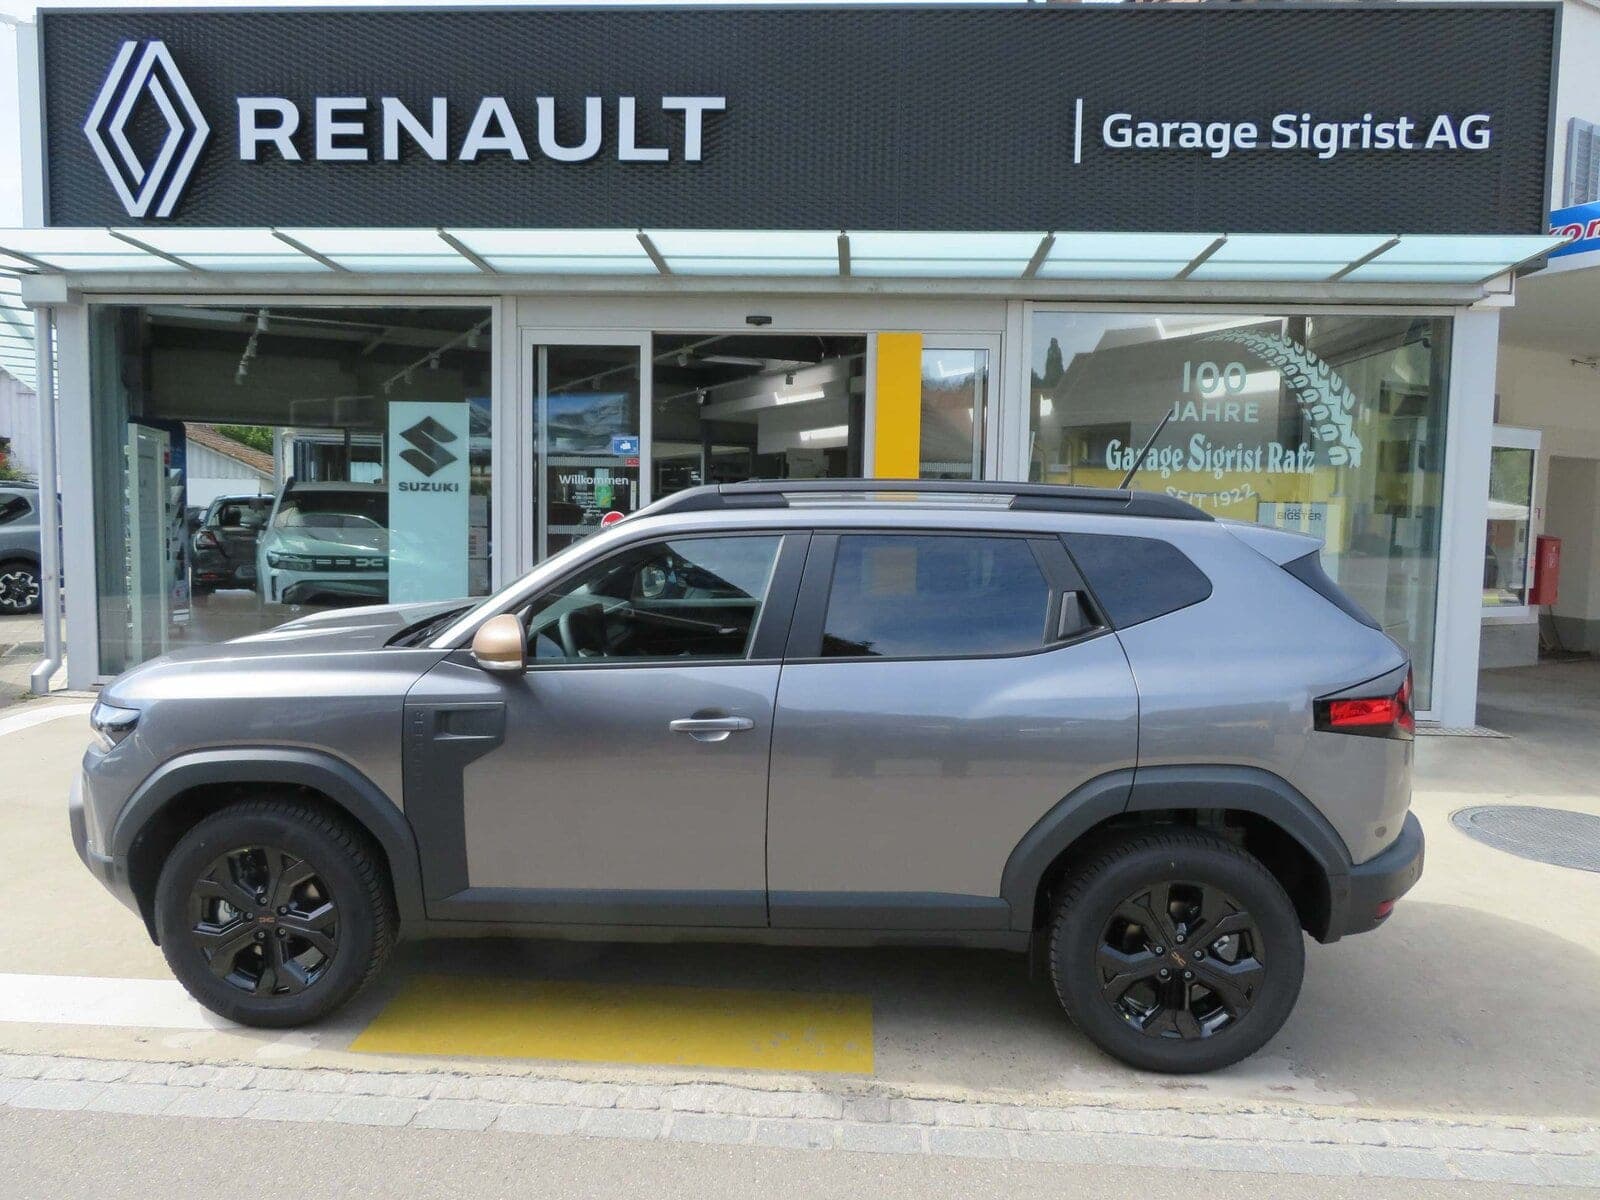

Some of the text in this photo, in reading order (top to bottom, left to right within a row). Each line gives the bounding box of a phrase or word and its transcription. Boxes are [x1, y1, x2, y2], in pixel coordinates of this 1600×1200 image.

[237, 96, 727, 162] RENAULT
[1102, 113, 1491, 159] Garage Sigrist AG
[1183, 360, 1247, 394] 100
[1168, 400, 1259, 423] JAHRE
[1187, 433, 1262, 480] Sigrist
[1267, 442, 1316, 473] Rafz
[398, 481, 459, 492] SUZUKI
[559, 474, 629, 485] Willkommen
[1213, 483, 1256, 509] 1922
[1276, 512, 1322, 521] BIGSTER
